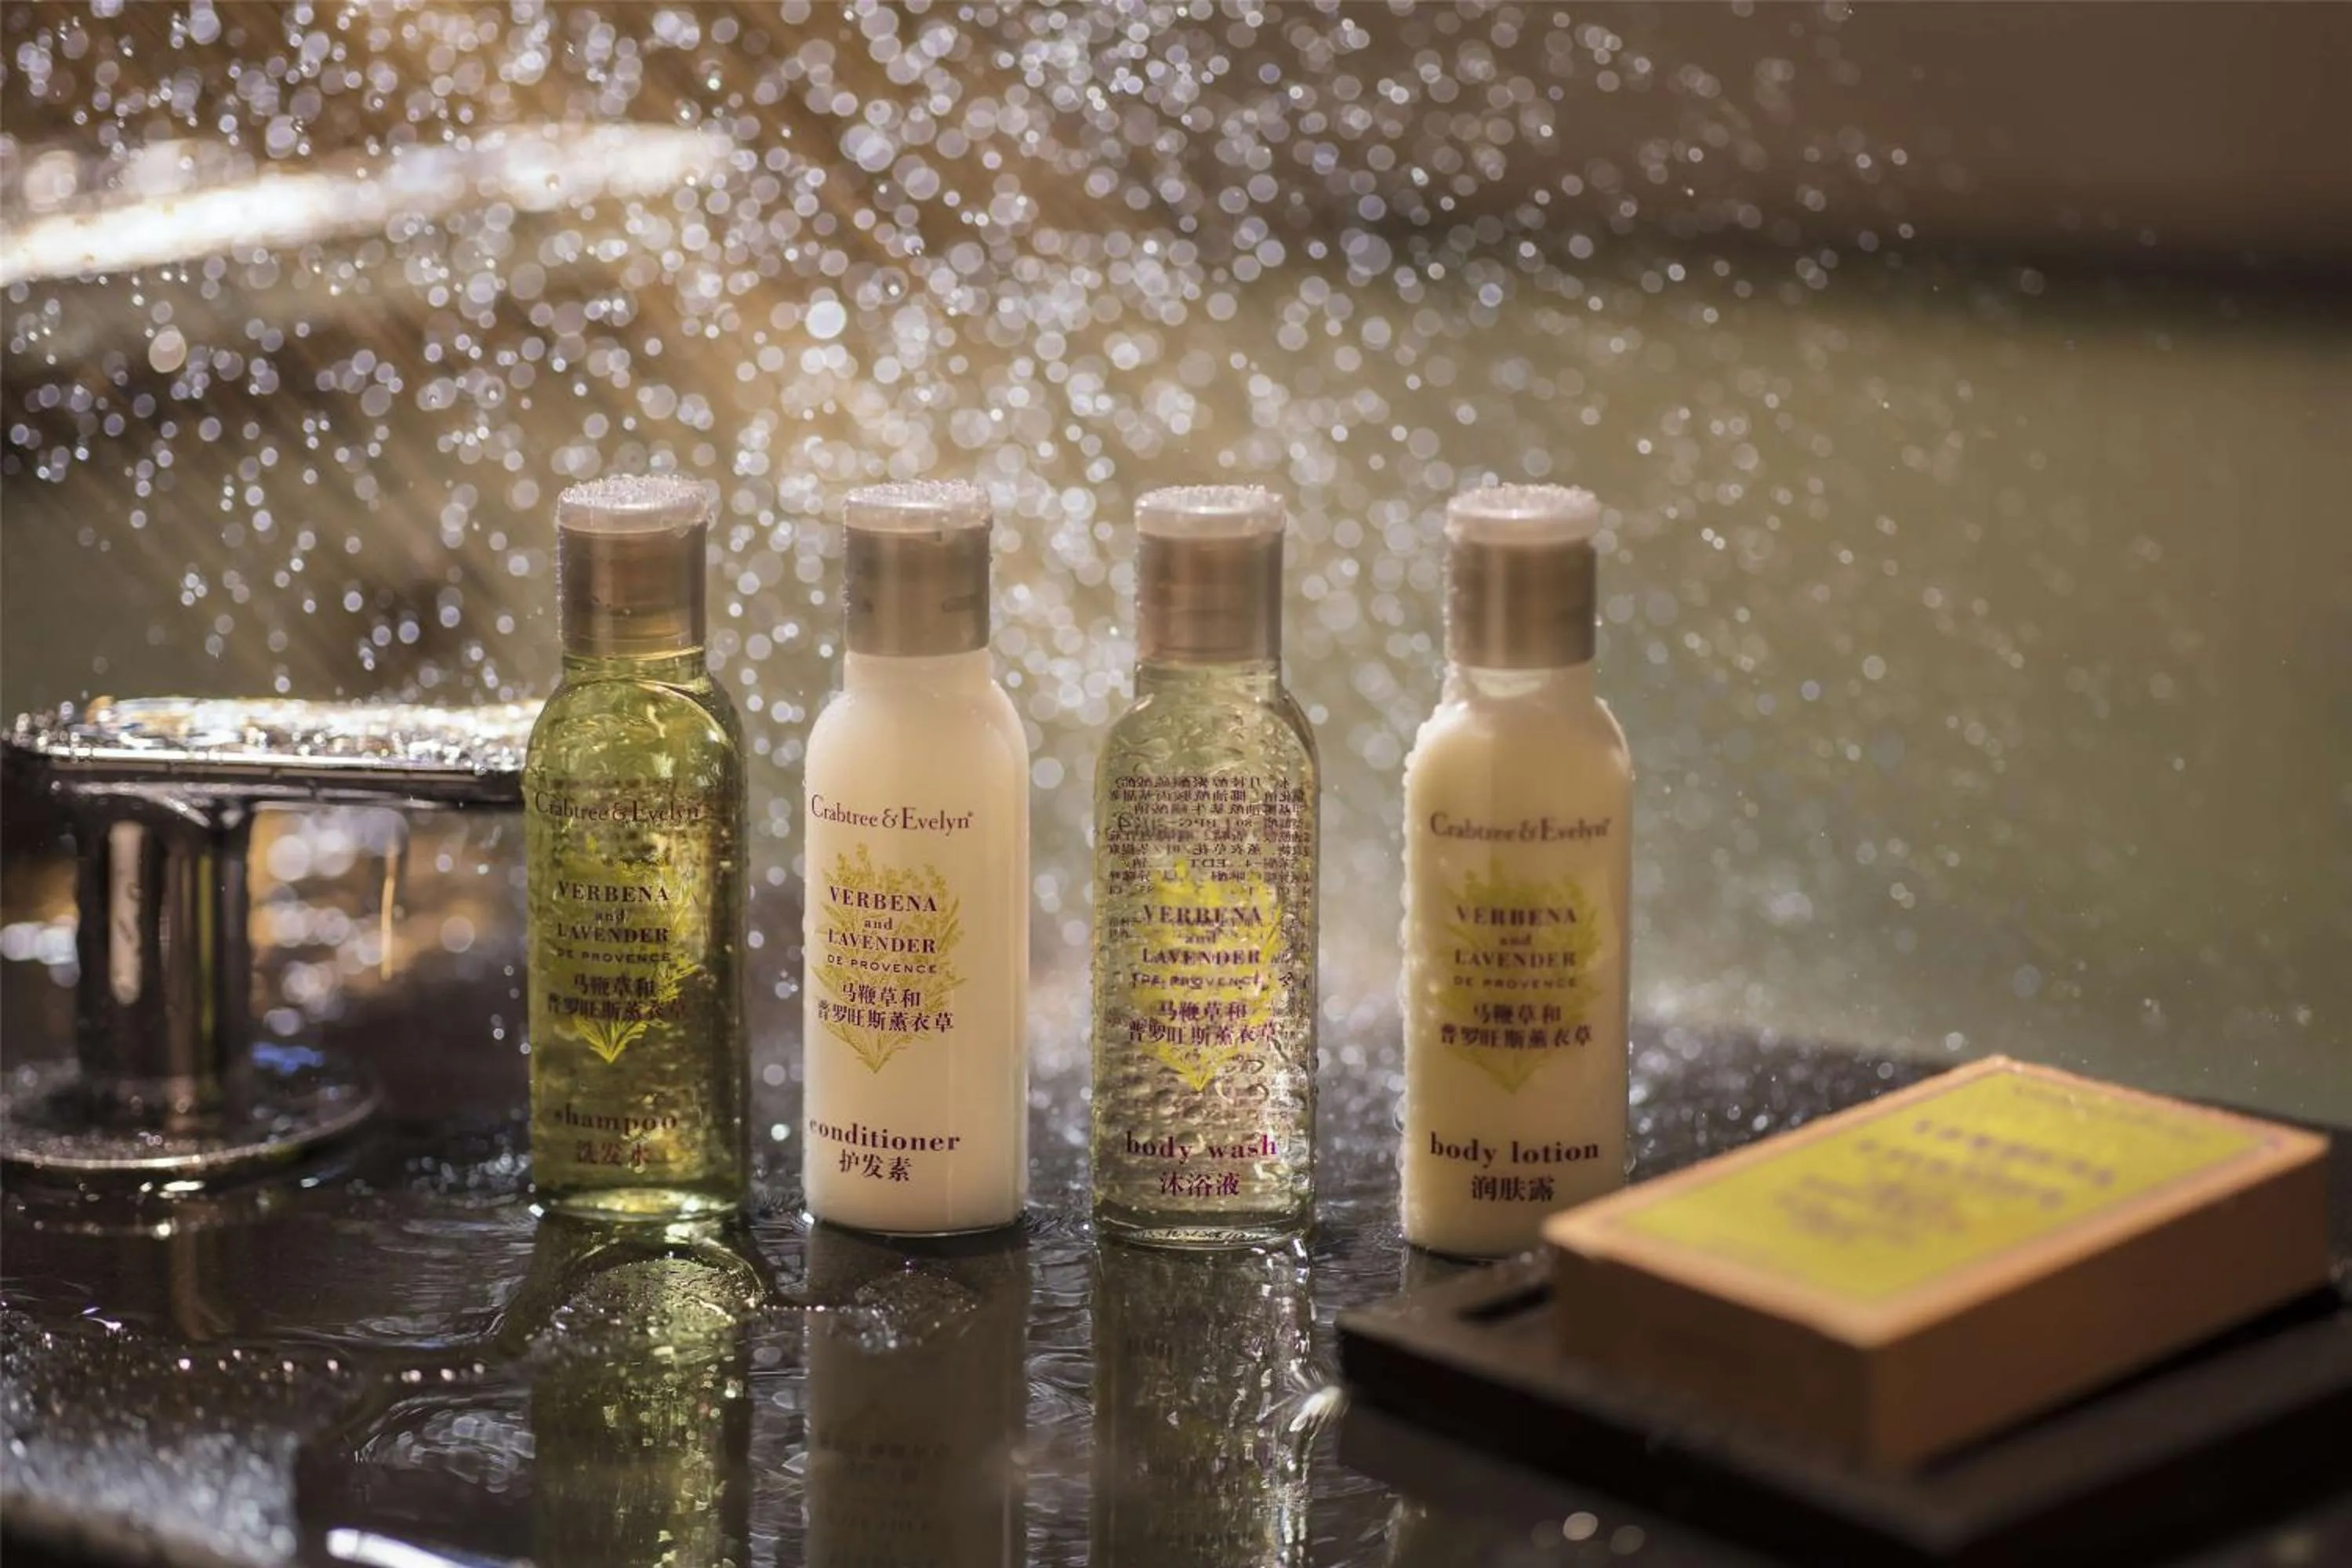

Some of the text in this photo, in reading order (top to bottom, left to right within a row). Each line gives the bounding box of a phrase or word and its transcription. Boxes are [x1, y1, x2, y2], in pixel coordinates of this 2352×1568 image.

[535, 792, 608, 821] Crabtree
[811, 794, 878, 827] Crabtree
[1430, 811, 1514, 842] Crabtree
[557, 880, 669, 902] VERBENA
[829, 886, 937, 912] VERBENA
[595, 909, 626, 924] and
[864, 918, 893, 930] and
[1143, 905, 1262, 926] VERBENA
[1457, 905, 1577, 926] VERBENA
[557, 923, 669, 942] LAVENDER
[828, 928, 935, 953] LAVENDER
[1185, 928, 1218, 943] and
[1499, 934, 1531, 946] and
[582, 949, 671, 964] PROVENCE
[827, 954, 937, 974] DE PROVENCE
[1143, 948, 1261, 964] LAVENDER
[1455, 949, 1577, 968] LAVENDER
[1454, 975, 1577, 989] DE PROVENCE
[842, 982, 920, 1007] 马鞭草和
[818, 1000, 953, 1033] 普罗旺斯薰衣草
[1474, 1004, 1562, 1025] 马鞭草和
[554, 1103, 677, 1136] shampoo
[810, 1119, 960, 1151] conditioner
[1127, 1131, 1277, 1164] body wash
[1430, 1131, 1599, 1168] body lotion
[840, 1149, 912, 1181] 护发素
[1160, 1171, 1240, 1197] 沐浴液
[1472, 1175, 1555, 1202] 润肤露
